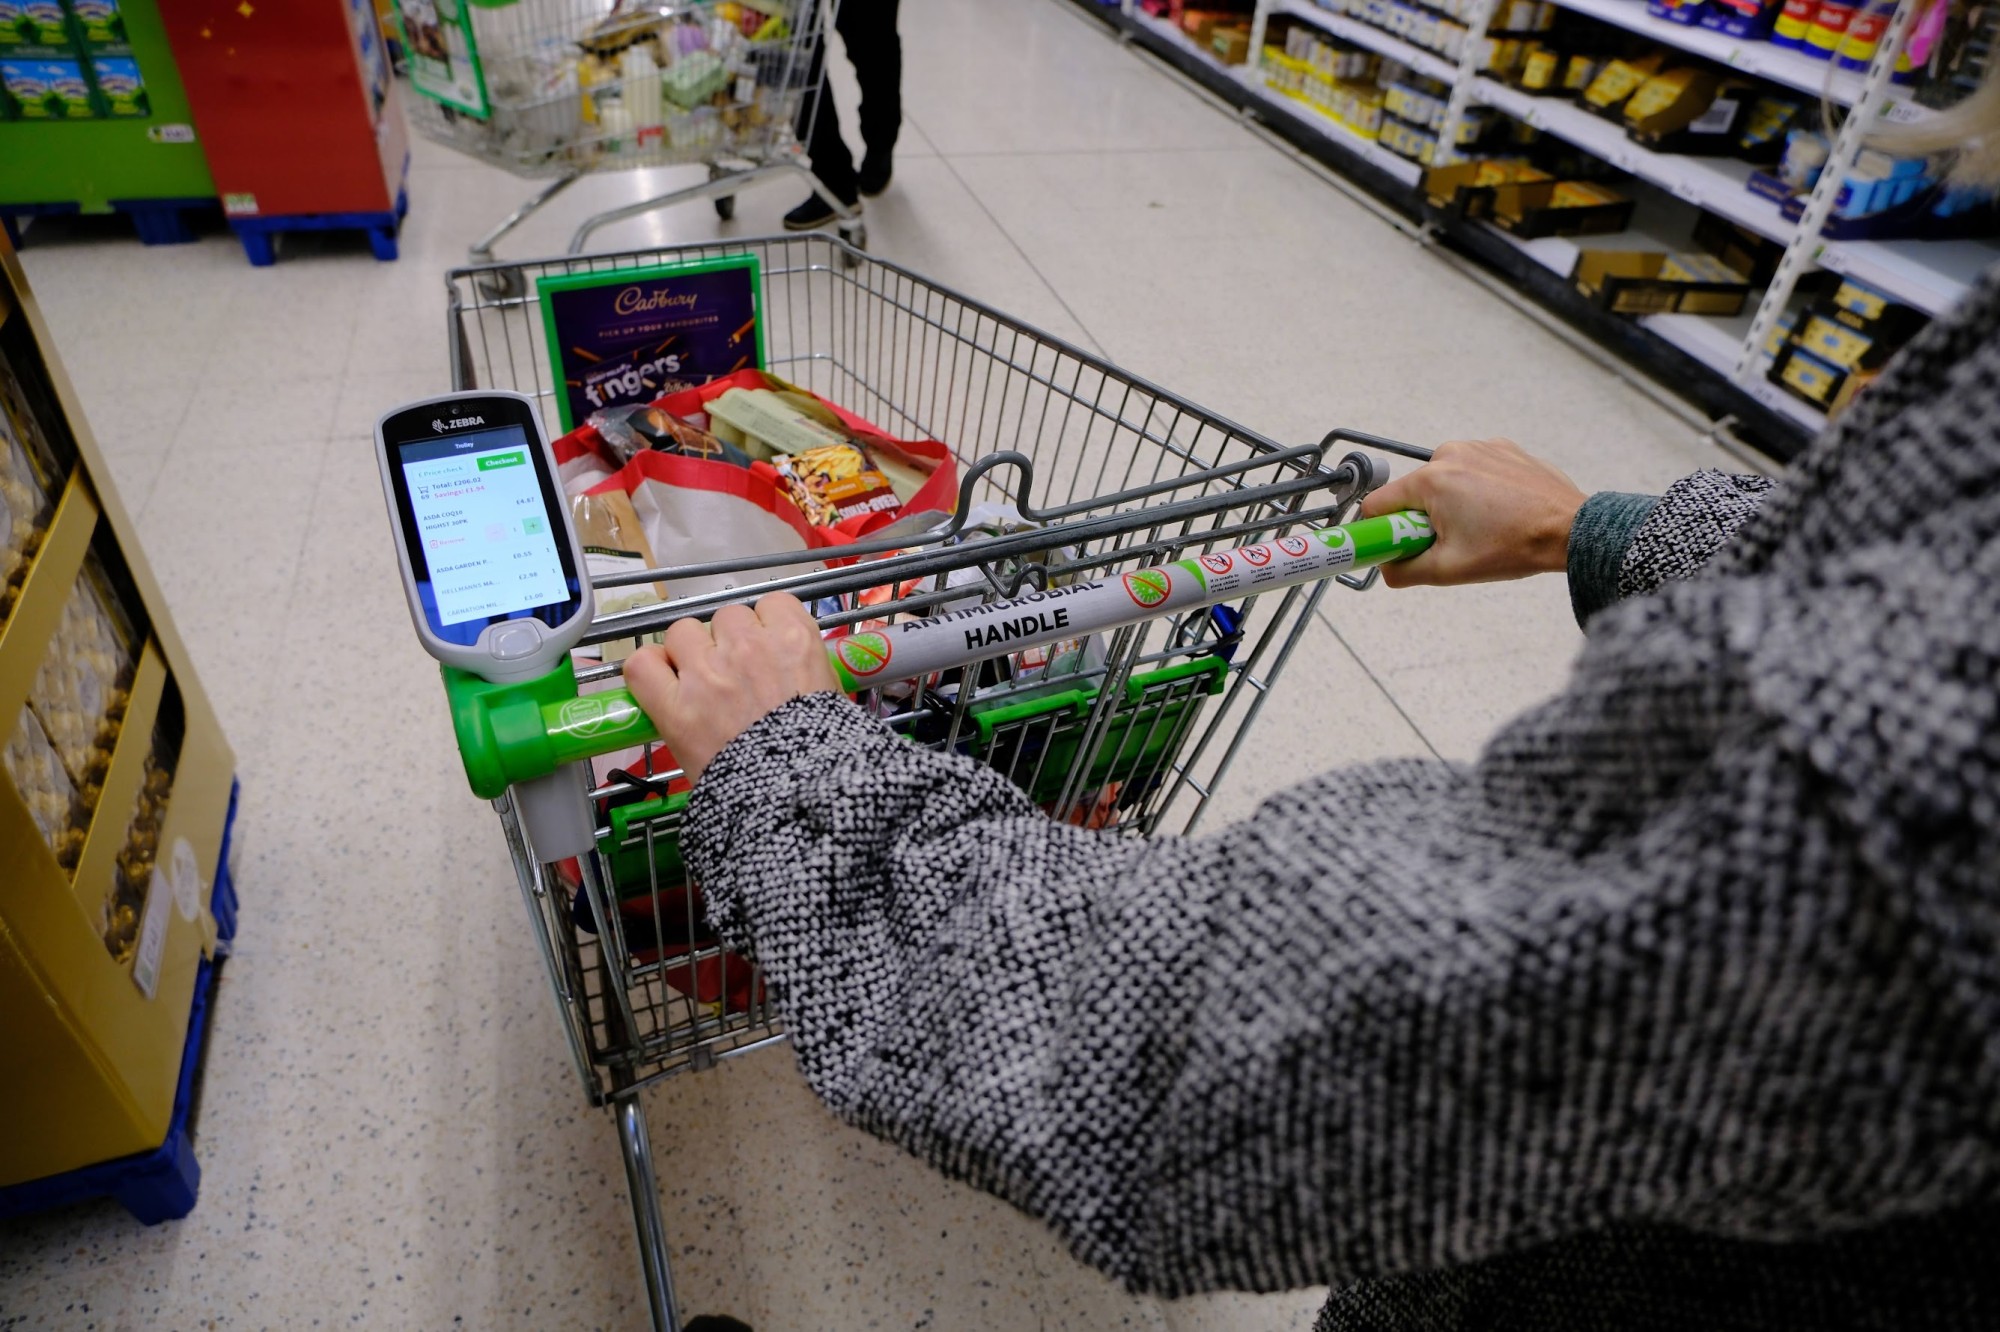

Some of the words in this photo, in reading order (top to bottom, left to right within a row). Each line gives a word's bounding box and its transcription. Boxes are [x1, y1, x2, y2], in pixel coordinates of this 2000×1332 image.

[614, 286, 698, 316] Cadbury
[586, 354, 680, 407] fingers
[449, 416, 485, 429] ZEBRA
[485, 456, 518, 467] Checkout
[432, 482, 452, 490] Total:
[423, 513, 440, 521] ASDA
[436, 565, 454, 573] ASDA
[455, 561, 482, 570] GARDEN
[964, 608, 1069, 650] HANDLE
